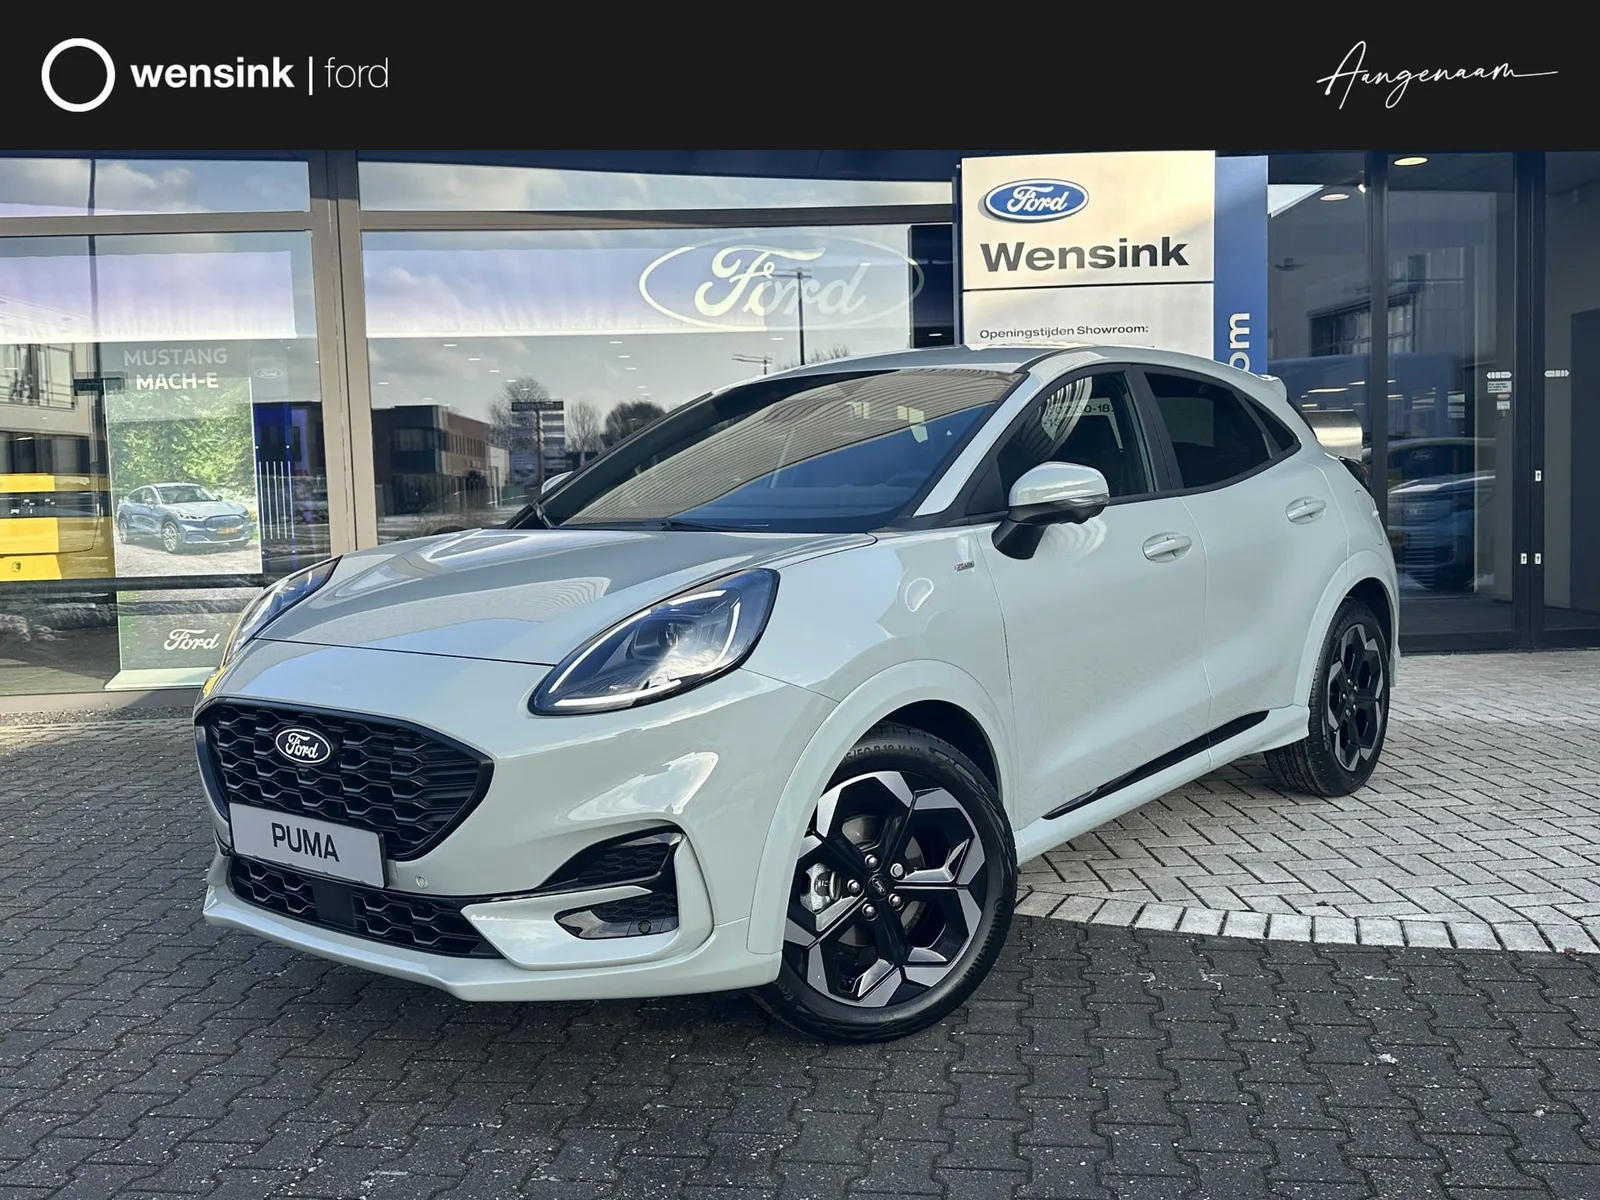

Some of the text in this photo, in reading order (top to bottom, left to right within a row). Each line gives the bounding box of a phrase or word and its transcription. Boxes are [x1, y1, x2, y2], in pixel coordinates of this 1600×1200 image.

[1006, 185, 1070, 213] Ford
[979, 236, 1189, 273] Wensink
[694, 244, 868, 318] Ford
[979, 325, 1149, 340] Openingstijden Showroom:
[123, 347, 228, 367] MUSTANG
[135, 372, 219, 390] MACH-E
[163, 628, 219, 651] Ford
[285, 732, 319, 759] Ford
[270, 822, 340, 863] PUMA
